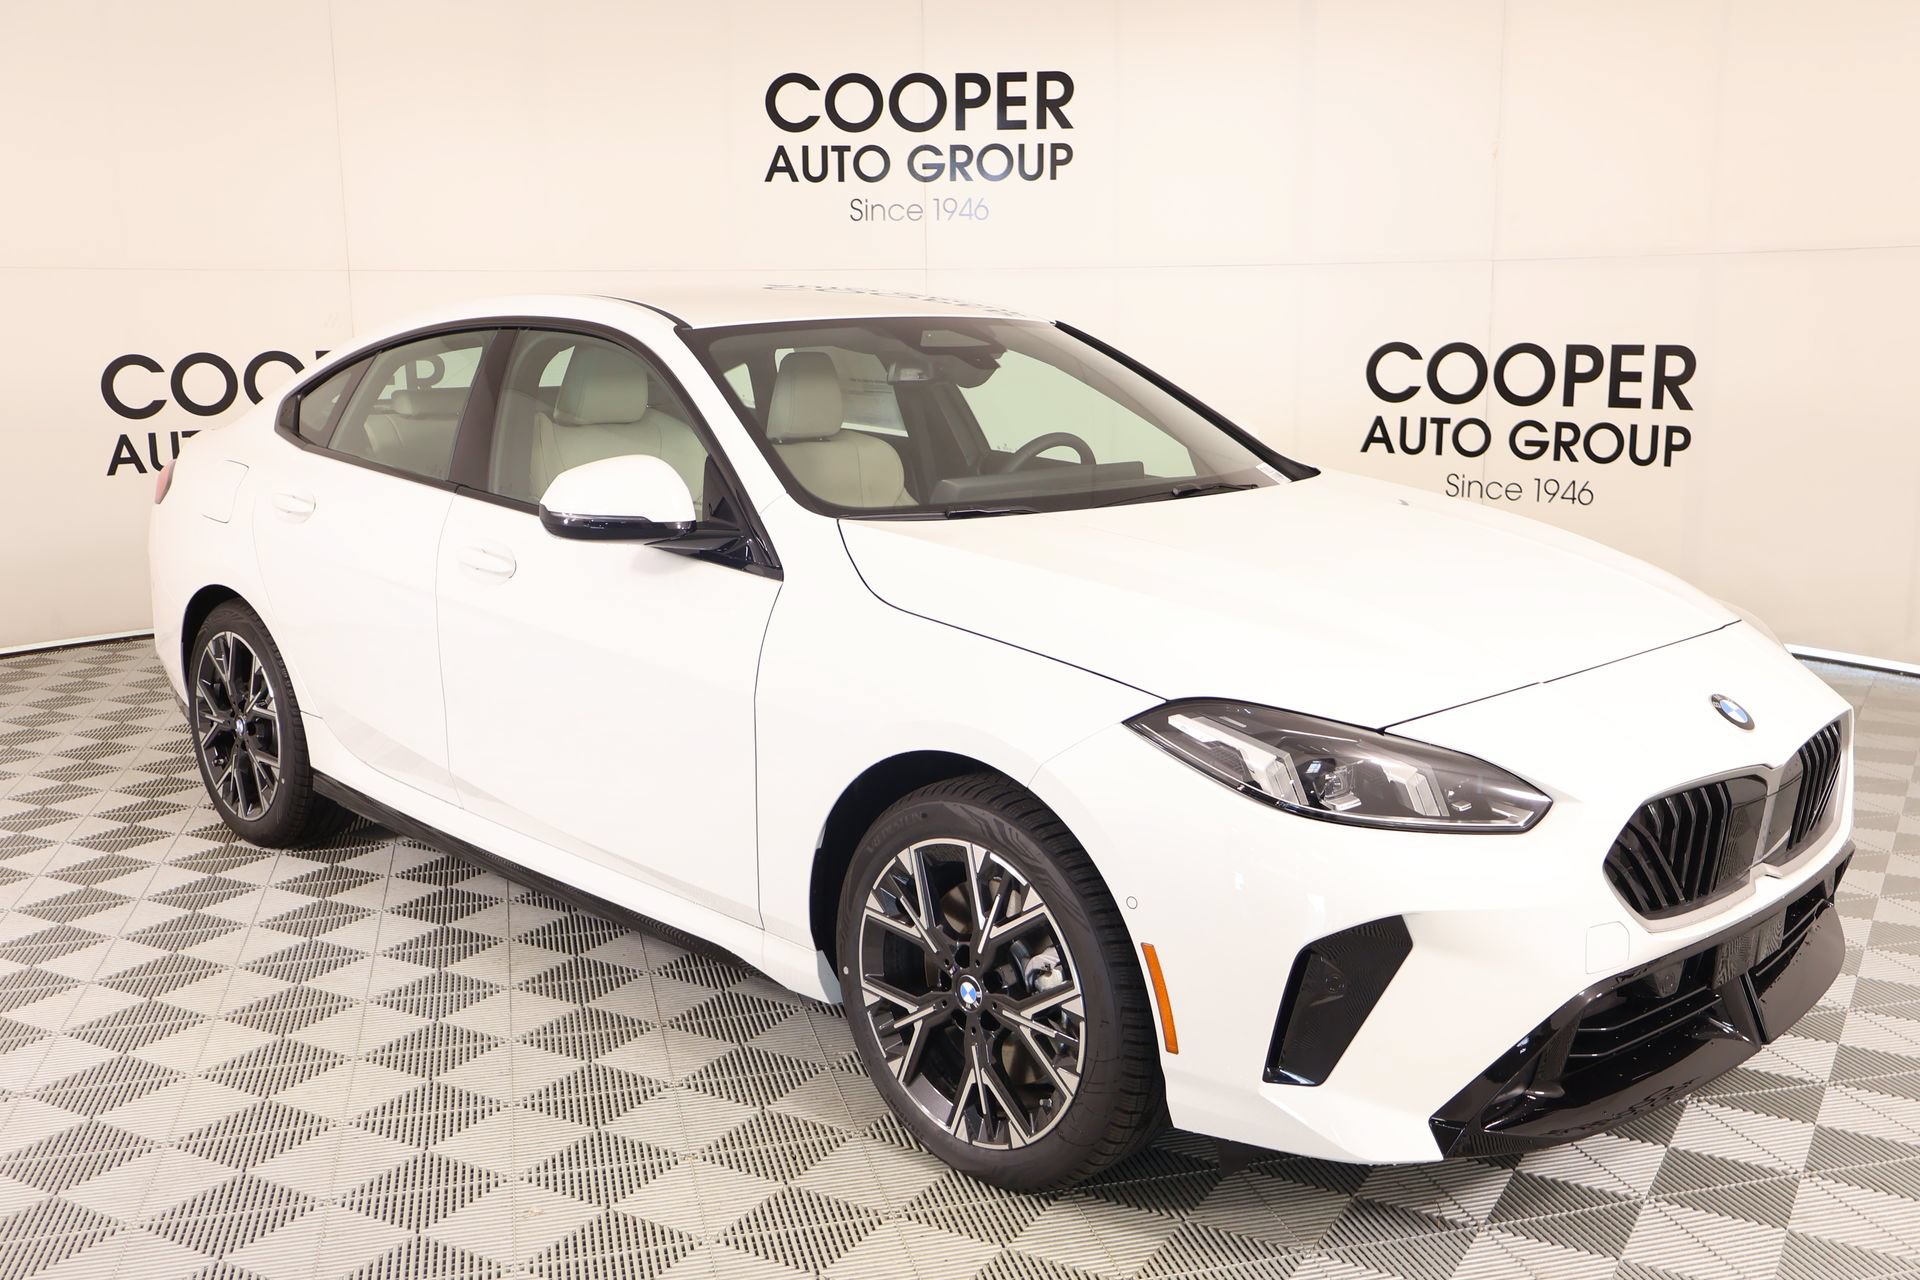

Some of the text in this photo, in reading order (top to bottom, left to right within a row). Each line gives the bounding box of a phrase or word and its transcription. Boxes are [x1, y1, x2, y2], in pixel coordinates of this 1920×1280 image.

[765, 71, 1075, 133] COOPER
[764, 143, 1074, 183] AUTO GROUP
[849, 197, 989, 222] Since 1946
[1366, 341, 1697, 411] COOPER
[1360, 415, 1692, 467] AUTO GROUP
[1445, 473, 1595, 506] Since 1946
